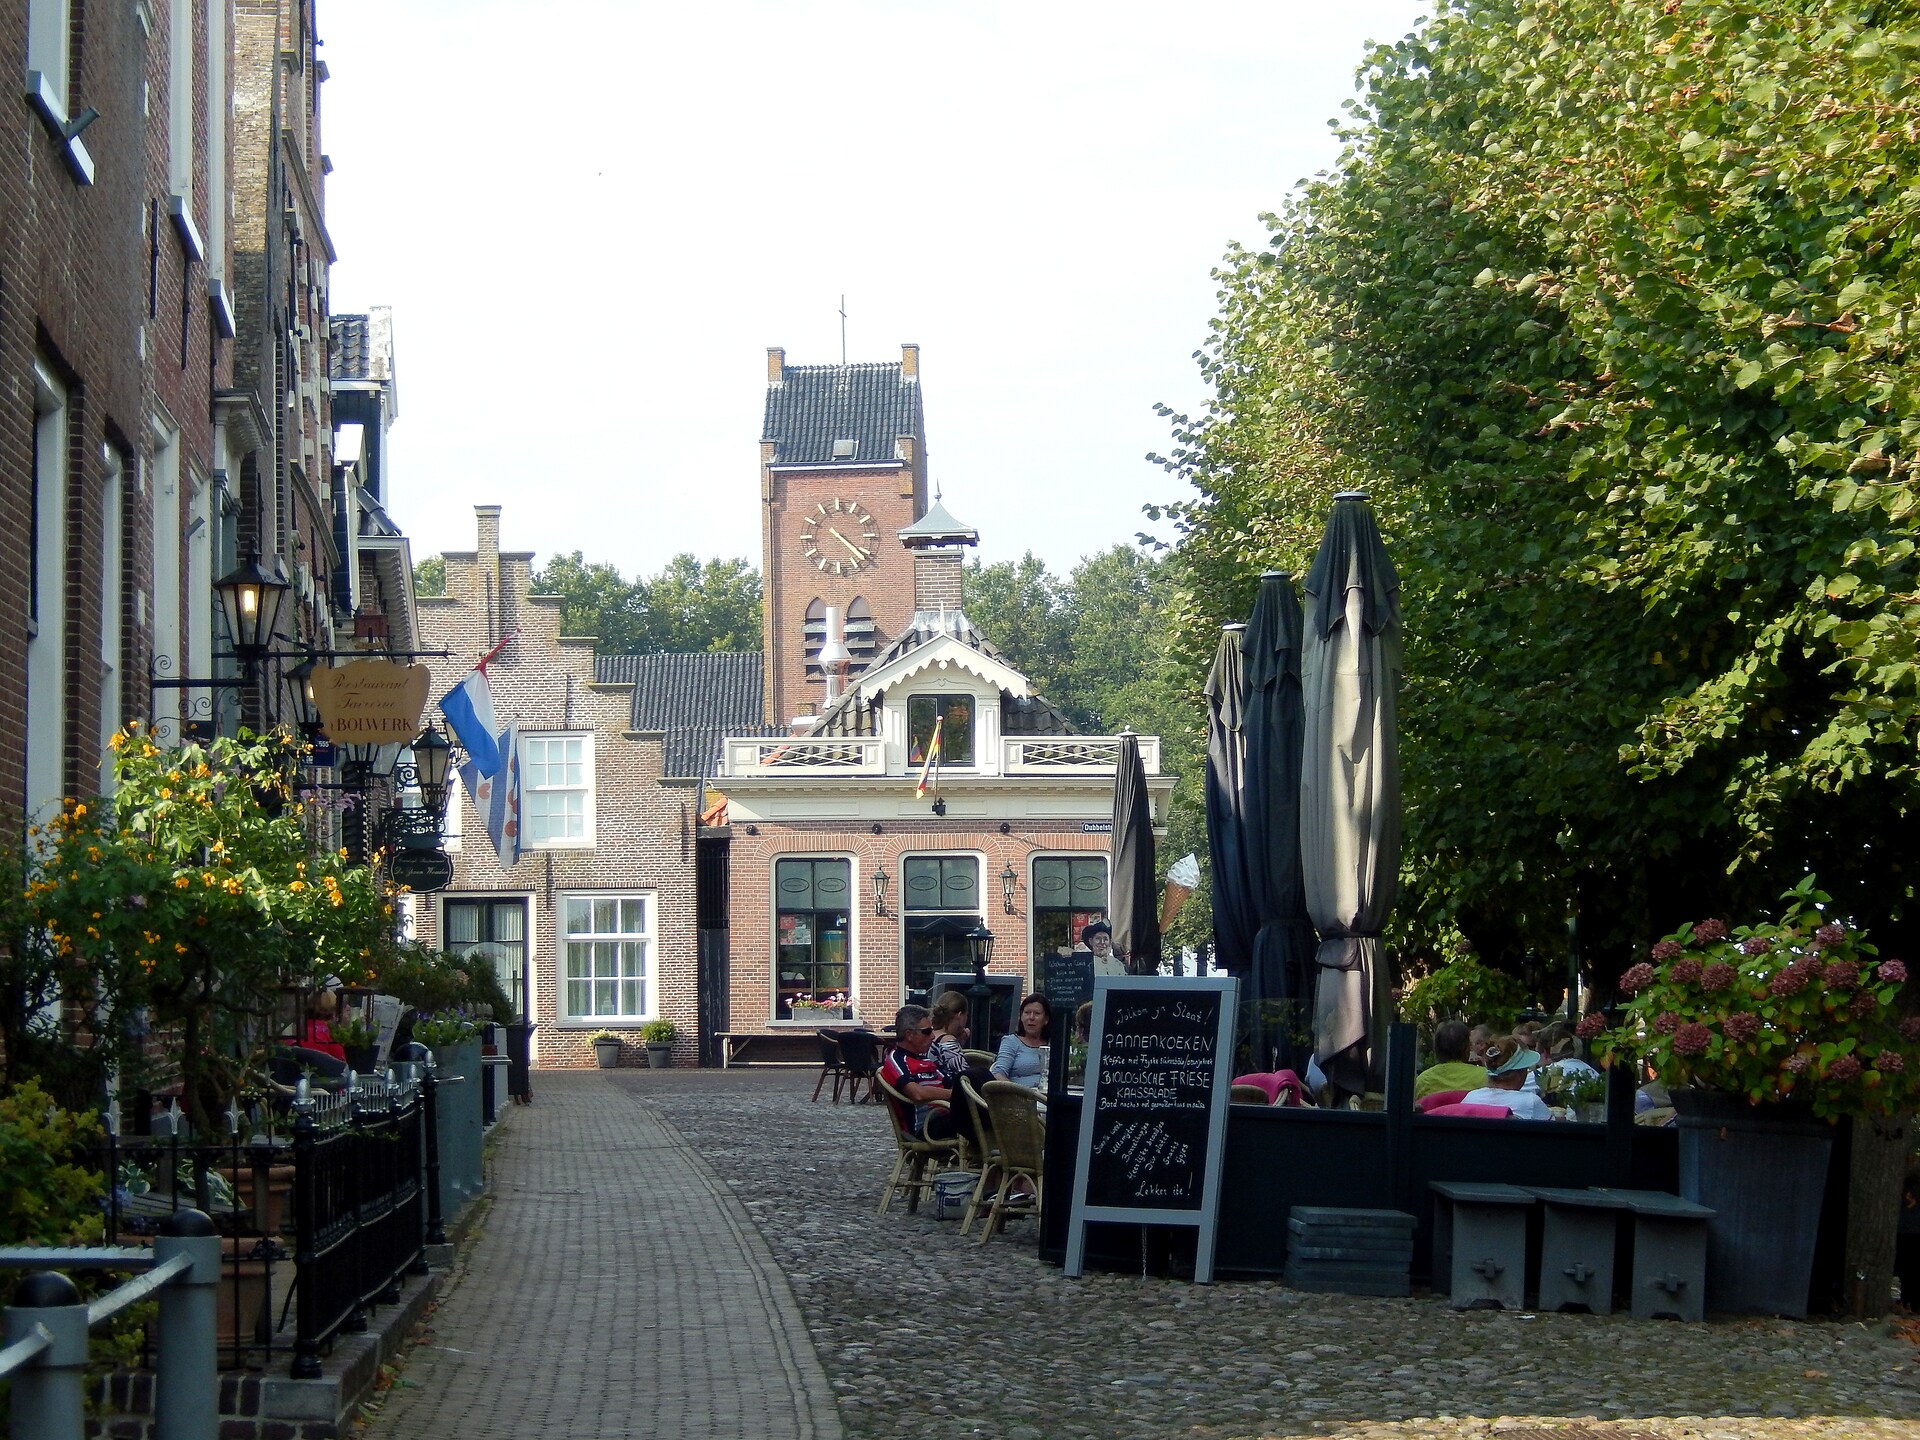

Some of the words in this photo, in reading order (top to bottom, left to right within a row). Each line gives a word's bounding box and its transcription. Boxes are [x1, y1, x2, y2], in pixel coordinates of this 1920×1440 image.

[330, 673, 410, 690] Restaurant
[340, 692, 395, 709] Taverne
[337, 717, 413, 732] BOLWERK
[1102, 1054, 1125, 1066] Koffie
[1100, 1068, 1167, 1086] BIOLOGISCHE
[1169, 1069, 1210, 1089] FRIESE
[1116, 1086, 1178, 1100] KAASSALADE
[1098, 1097, 1118, 1110] Bord
[1134, 1180, 1168, 1197] Lekker
